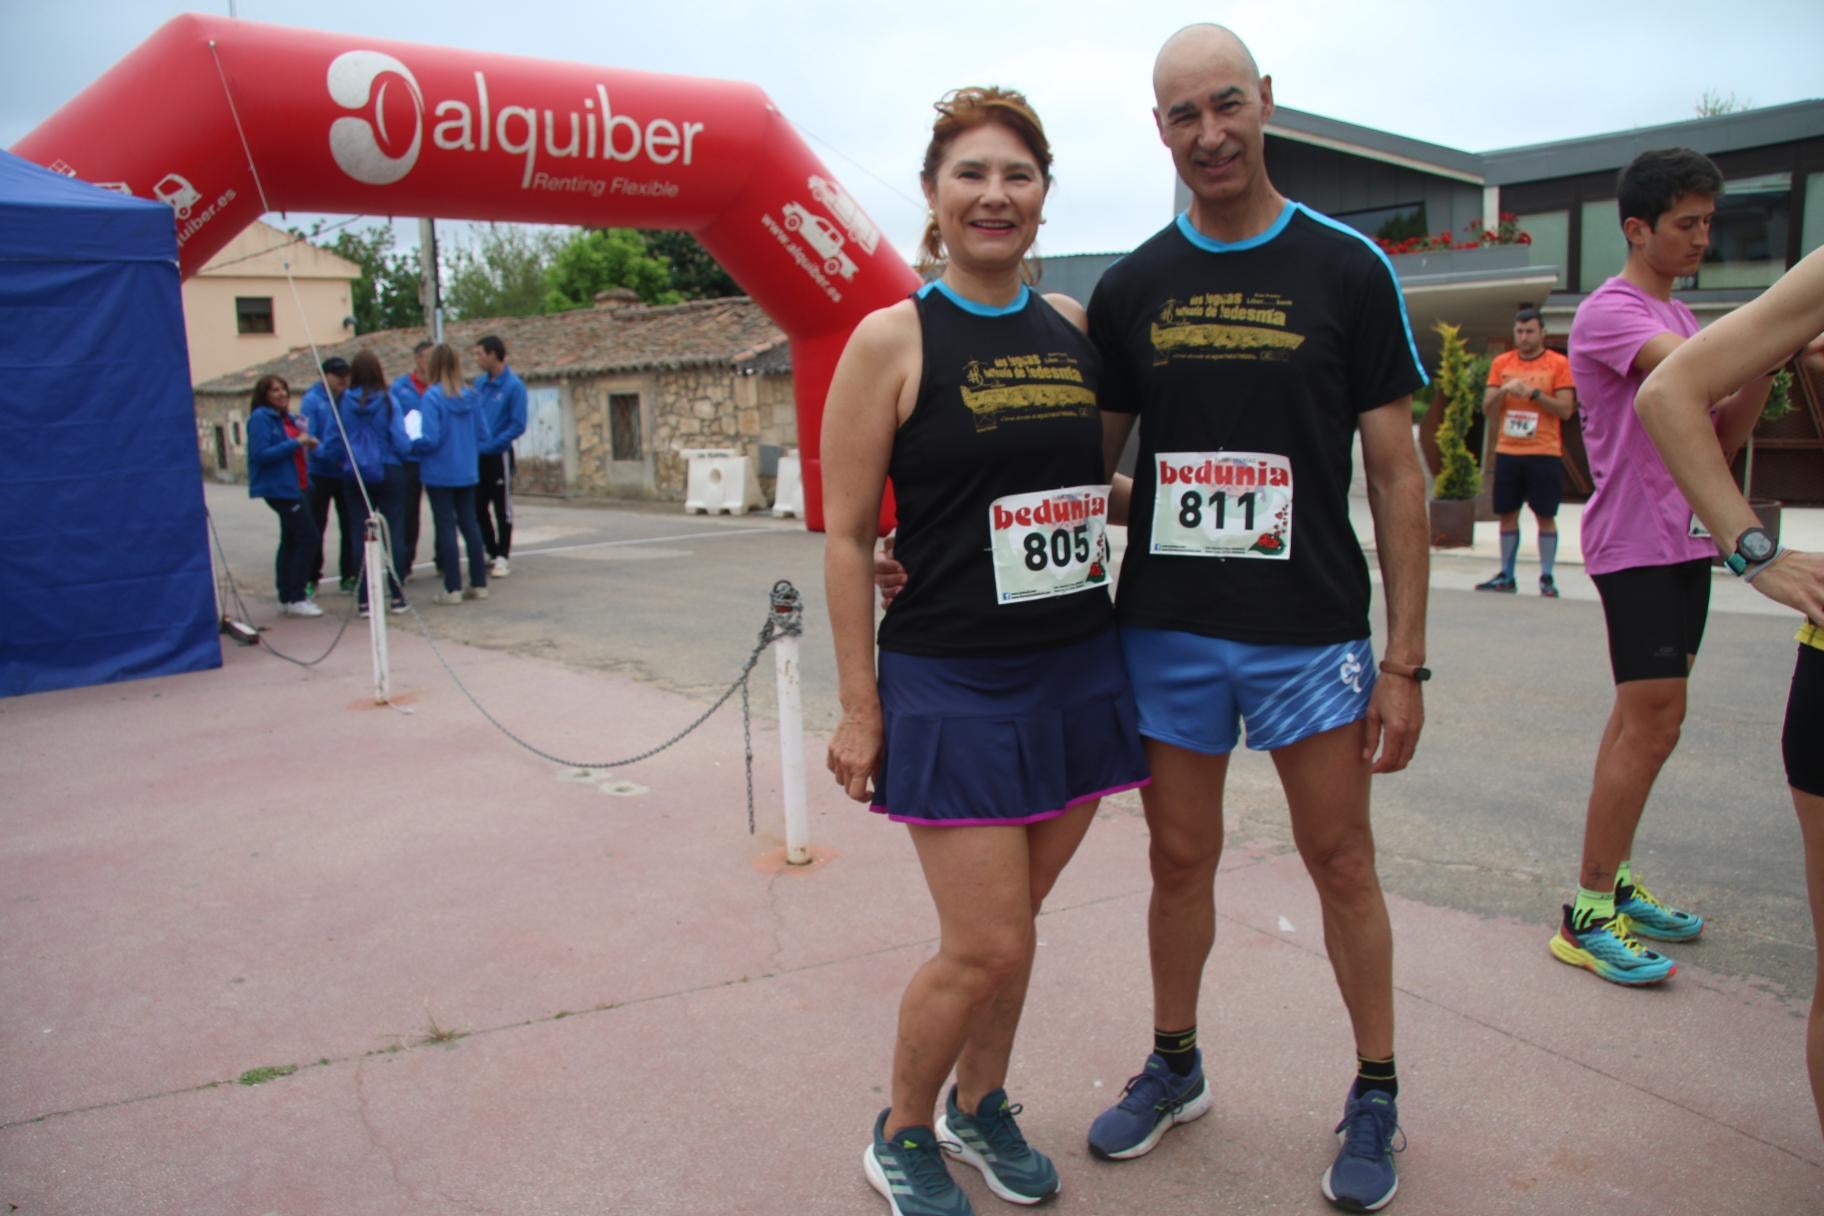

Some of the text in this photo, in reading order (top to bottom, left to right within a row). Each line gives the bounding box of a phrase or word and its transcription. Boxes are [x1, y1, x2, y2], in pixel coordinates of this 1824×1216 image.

[433, 71, 704, 189] alquiber
[533, 172, 679, 198] Renting Flexible
[761, 213, 843, 304] www.alquiber.es
[1160, 460, 1289, 487] bedunia
[994, 494, 1105, 531] bedunia
[1179, 490, 1256, 530] 811
[1024, 525, 1090, 571] 805
